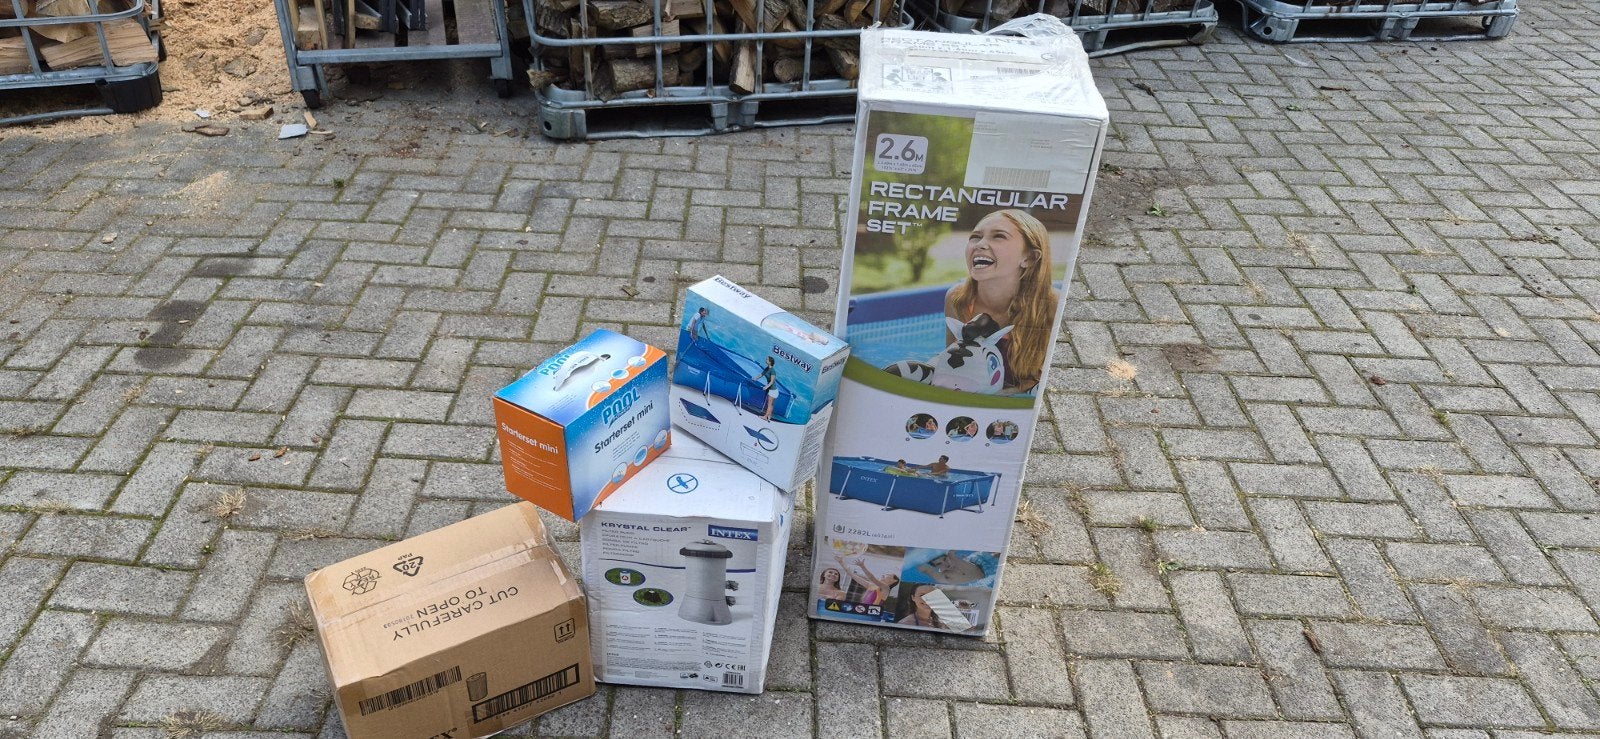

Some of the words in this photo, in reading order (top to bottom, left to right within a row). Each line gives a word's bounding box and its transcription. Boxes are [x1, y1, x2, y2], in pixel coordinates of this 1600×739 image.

[869, 180, 1069, 210] RECTANGULAR
[867, 200, 960, 223] FRAME
[714, 276, 752, 300] Bestway
[772, 344, 814, 373] Bestway
[602, 386, 641, 425] POOL
[594, 413, 637, 454] Starterset
[636, 399, 654, 423] mini
[501, 422, 538, 448] Starterset
[539, 442, 559, 455] mini
[601, 521, 651, 531] KRYSTAL
[710, 527, 753, 541] INTEX
[397, 552, 414, 561] PAP
[402, 562, 416, 571] 20
[466, 586, 487, 600] TO
[489, 586, 519, 604] CUT
[416, 594, 461, 616] OPEN
[392, 599, 484, 642] CAREFULLY
